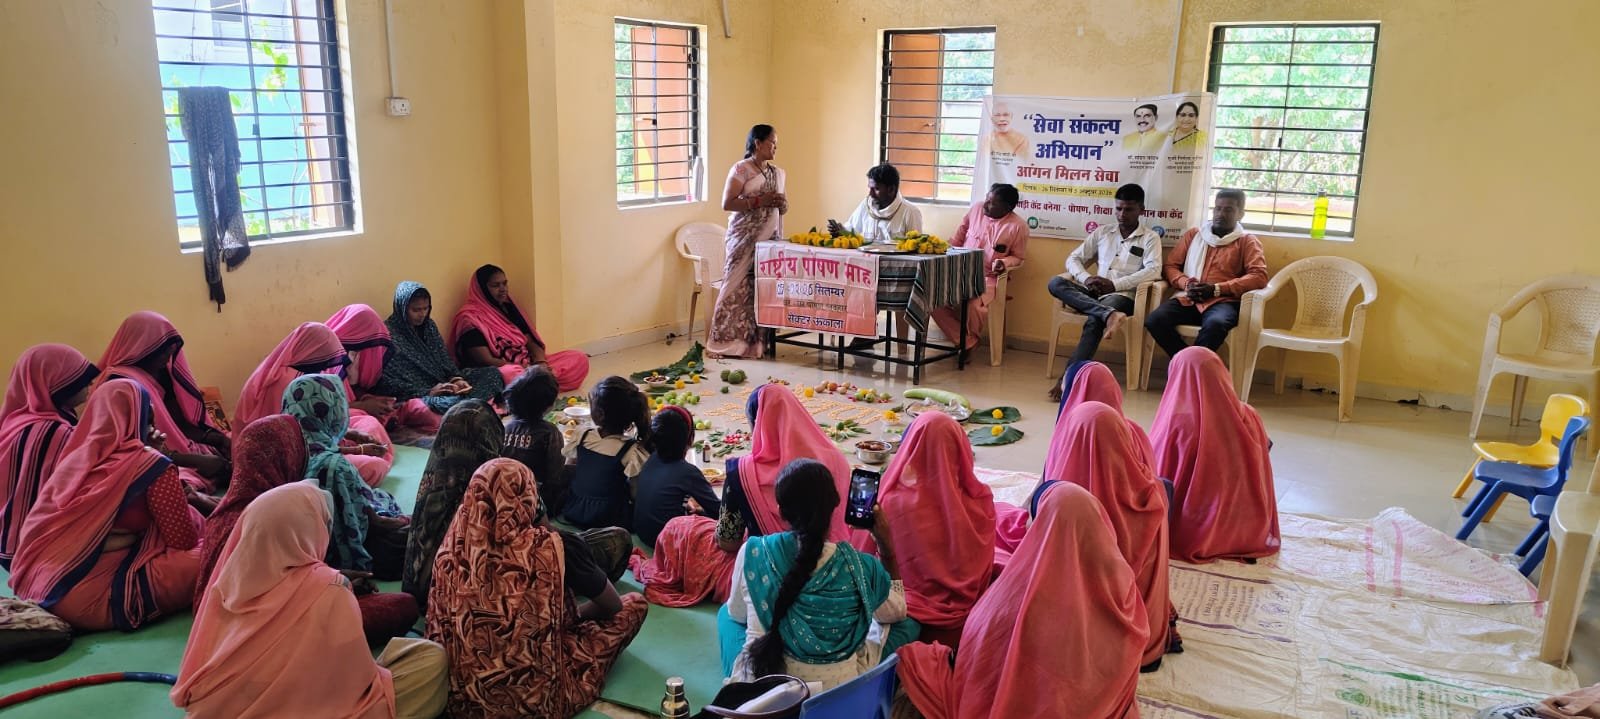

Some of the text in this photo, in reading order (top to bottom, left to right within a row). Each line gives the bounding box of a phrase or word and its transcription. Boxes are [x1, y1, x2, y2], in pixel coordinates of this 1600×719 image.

[1069, 113, 1122, 134] संकल्प
[1035, 140, 1113, 160] अभियान”
[1017, 163, 1120, 183] आंगन मिलन सेवा
[1093, 204, 1113, 216] शिक्षा
[1157, 209, 1168, 219] का
[1169, 208, 1183, 219] केंद्र
[760, 250, 872, 285] राष्ट्रीय पोषण माह
